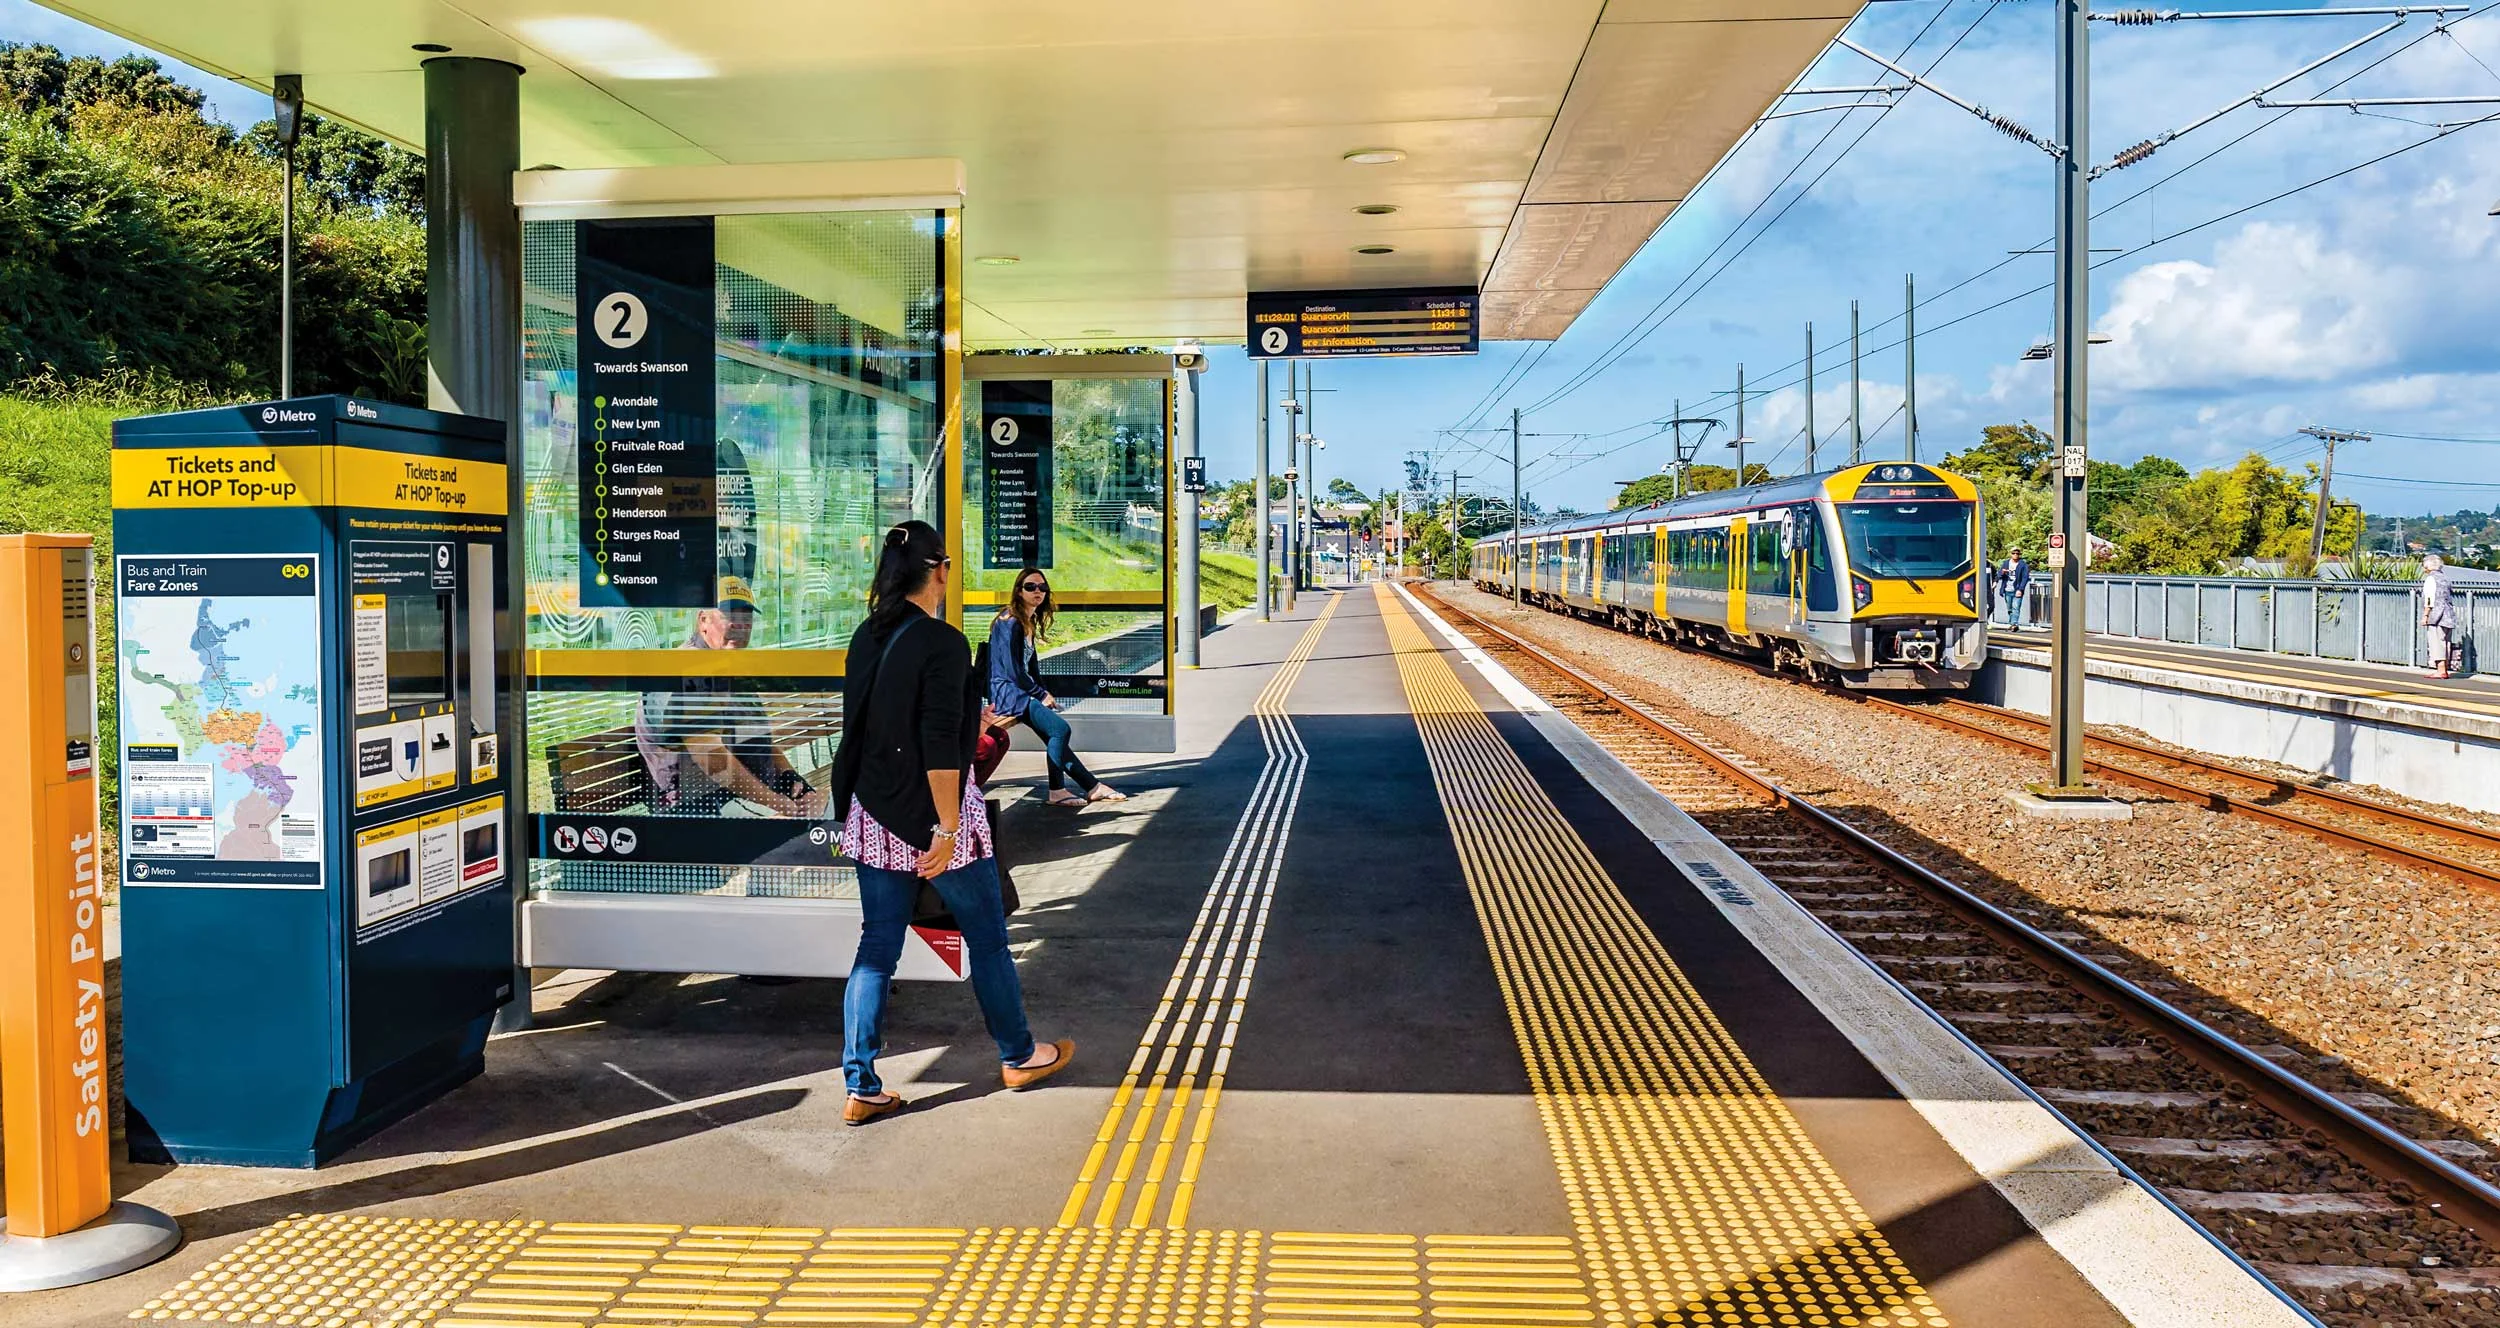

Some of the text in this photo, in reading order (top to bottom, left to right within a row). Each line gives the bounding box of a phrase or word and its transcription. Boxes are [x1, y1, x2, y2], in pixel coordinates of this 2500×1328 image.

[611, 301, 632, 339] 2
[1431, 322, 1456, 330] 12:04
[1269, 331, 1279, 348] 2
[594, 362, 688, 373] Towards Swanson
[611, 396, 658, 407] Avondale
[280, 410, 316, 421] Metro
[357, 406, 377, 418] Metro
[611, 419, 660, 430] New Lynn
[999, 422, 1011, 440] 2
[612, 440, 684, 451] Fruitvale Road
[2067, 447, 2082, 455] NAL
[167, 454, 276, 474] Tickets and
[1186, 459, 1203, 469] EMU
[2068, 457, 2082, 465] 017
[405, 463, 457, 482] Tickets and
[612, 463, 662, 473] Glen Eden
[1192, 471, 1198, 482] 3
[148, 479, 296, 501] AT HOP Top-up
[612, 485, 663, 498] Sunnyvale
[395, 484, 466, 508] AT HOP Top-up
[612, 508, 667, 518] Henderson
[350, 518, 365, 528] Please
[613, 530, 680, 542] Sturges Road
[613, 552, 642, 562] Ranui
[127, 563, 207, 576] Bus and Train
[127, 580, 198, 591] Fare Zones
[613, 575, 658, 585] Swanson
[151, 867, 176, 876] Metro
[69, 831, 103, 1137] Safety Point
